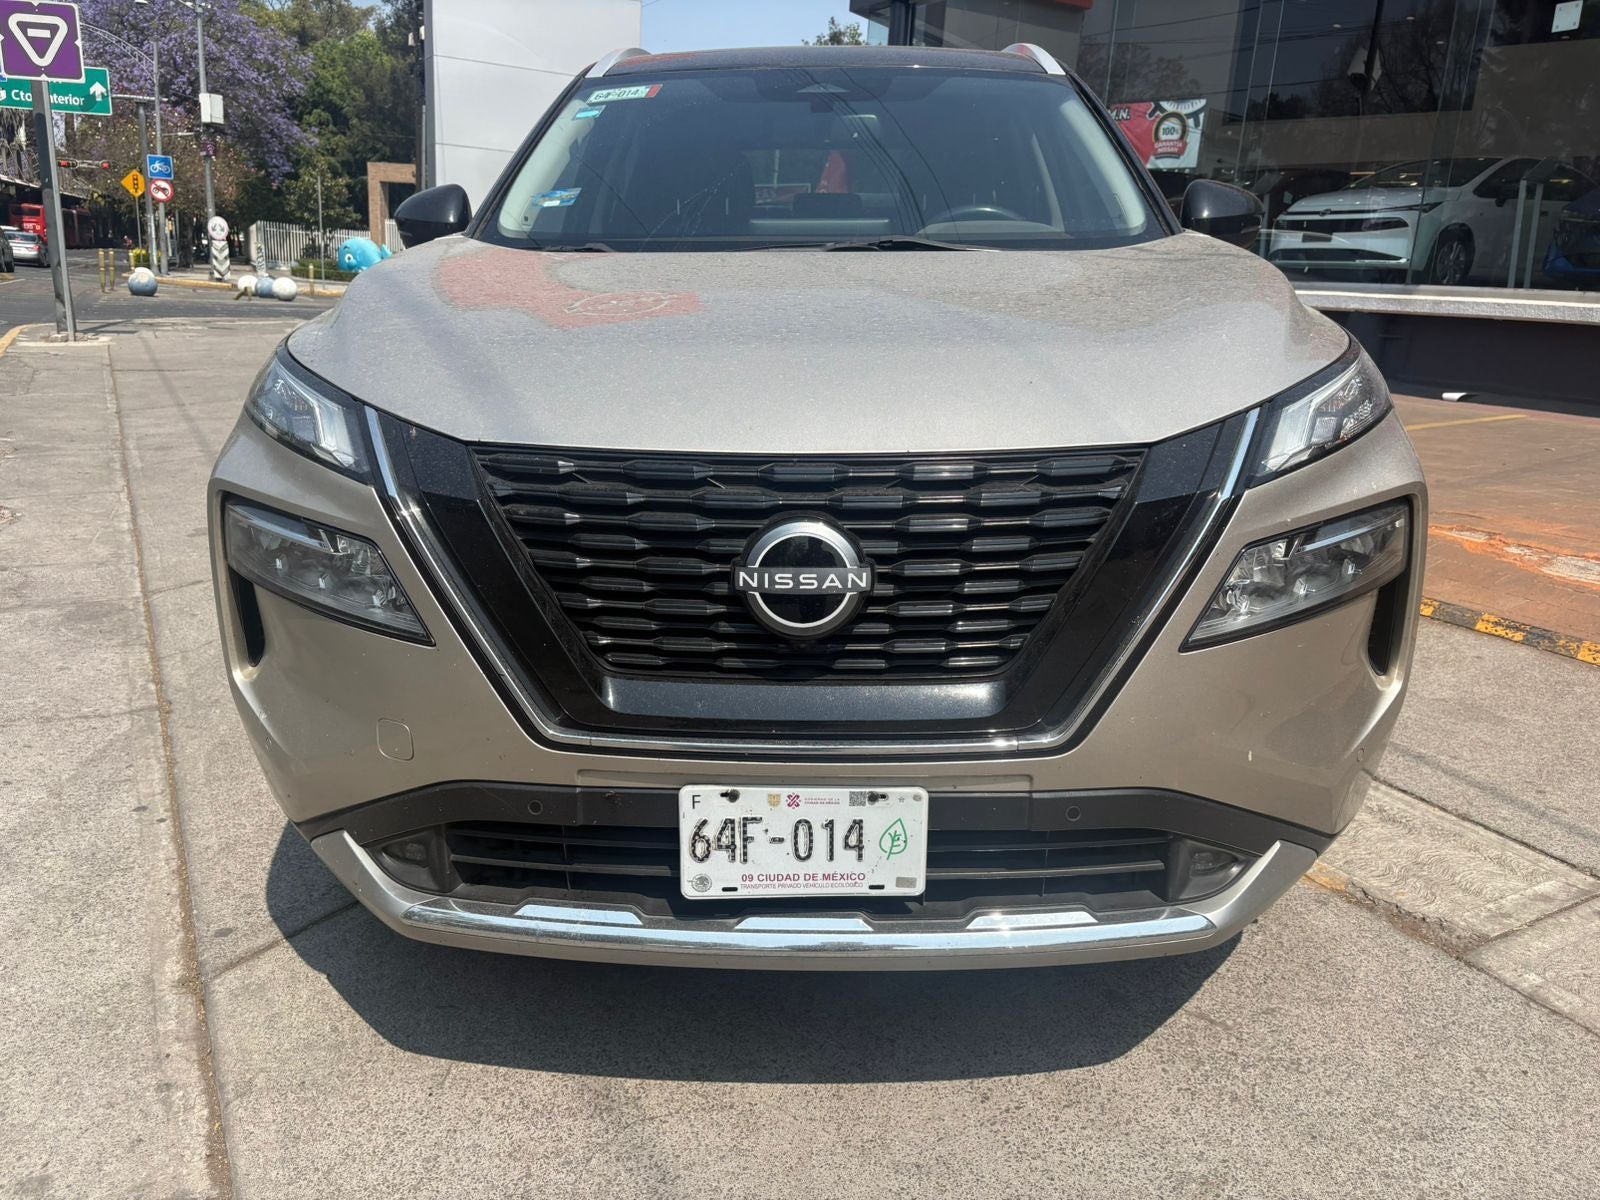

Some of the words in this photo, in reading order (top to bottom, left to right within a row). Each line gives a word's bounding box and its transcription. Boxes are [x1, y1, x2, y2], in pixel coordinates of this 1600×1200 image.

[50, 93, 85, 106] terior
[739, 571, 867, 589] NISSAN
[692, 794, 701, 810] F
[688, 816, 866, 864] 64F-014
[741, 873, 754, 882] 09
[757, 873, 800, 882] CIUDAD
[803, 873, 819, 882] DE
[822, 870, 866, 881] MÉXICO
